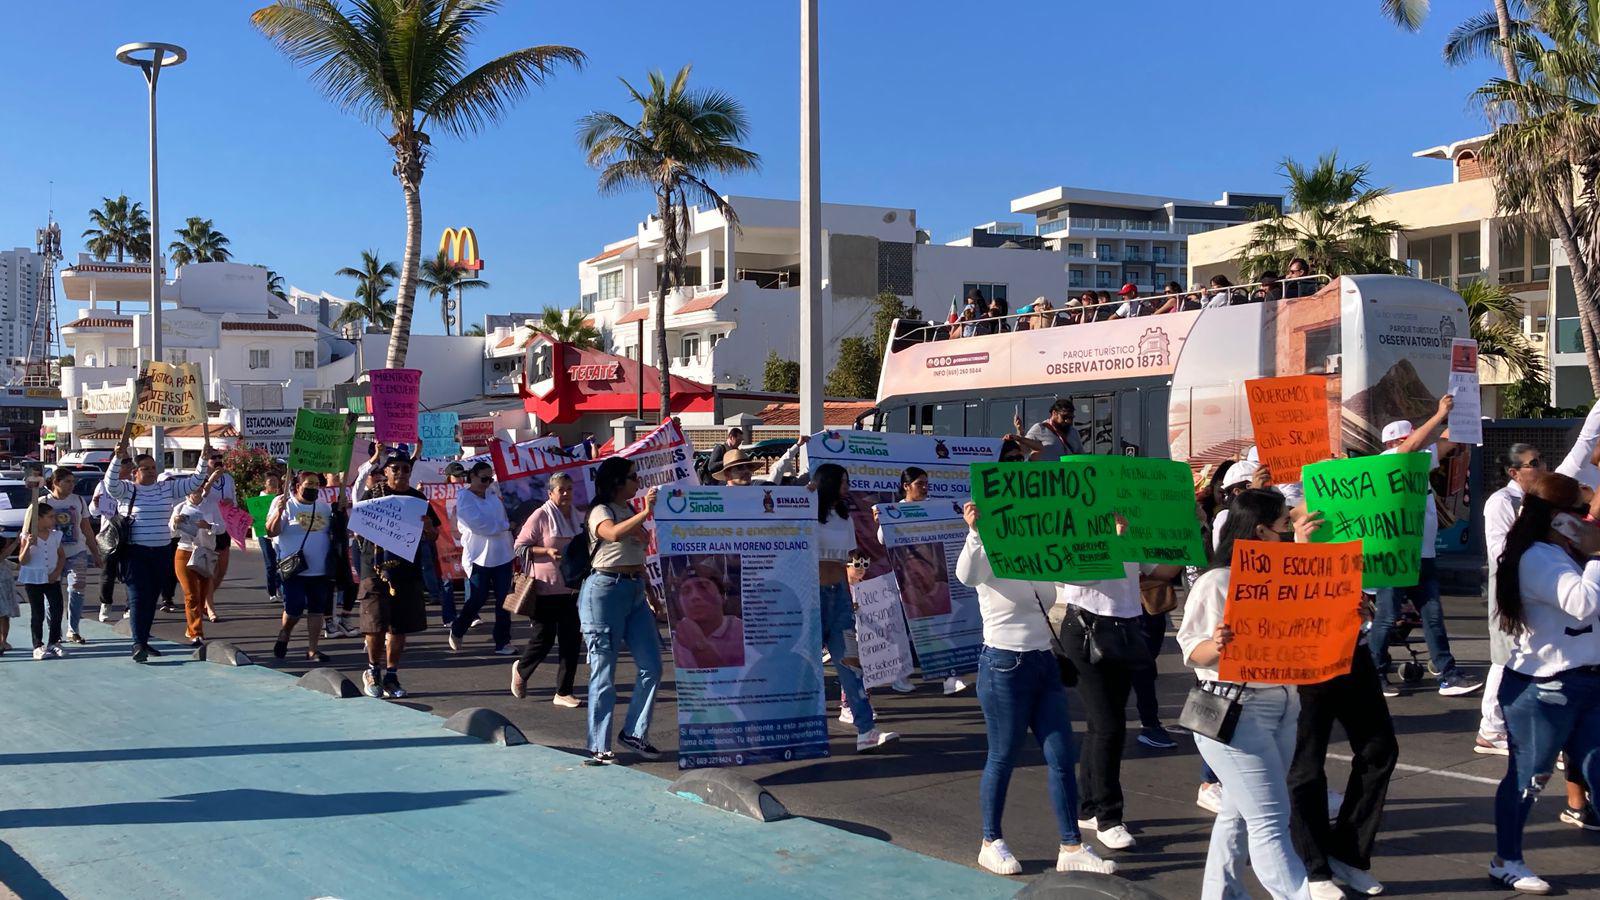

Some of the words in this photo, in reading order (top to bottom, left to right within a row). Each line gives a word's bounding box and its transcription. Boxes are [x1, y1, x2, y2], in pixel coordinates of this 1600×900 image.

[1379, 334, 1440, 348] OBSERVATORIO
[1063, 349, 1093, 359] PARQUE
[1095, 345, 1135, 357] TURÍSTICO
[567, 361, 619, 381] TECATE
[1046, 357, 1134, 375] OBSERVATORIO
[1137, 354, 1163, 368] 1873
[1251, 386, 1309, 404] QUEREMOS
[246, 416, 296, 429] ESTACIONAMIEN
[270, 440, 287, 457] $100
[849, 445, 889, 457] Sinaloa
[675, 466, 691, 482] A:
[982, 466, 1096, 507] EXIGIMOS
[1312, 471, 1377, 500] HASTA
[690, 501, 724, 513] Sinaloa
[991, 504, 1077, 539] JUSTICIA
[1087, 511, 1114, 537] NOS
[671, 542, 707, 552] ROISSER
[709, 542, 733, 551] ALAN
[734, 541, 772, 551] MORENO
[774, 541, 809, 551] SOLANO
[990, 551, 1043, 575] FALTAN
[1045, 543, 1063, 573] 5
[1283, 556, 1333, 576] ESCUCHA
[1235, 579, 1272, 601] ESTÁ
[1278, 586, 1298, 600] EN
[1304, 583, 1319, 600] LA
[1245, 644, 1272, 660] QUE
